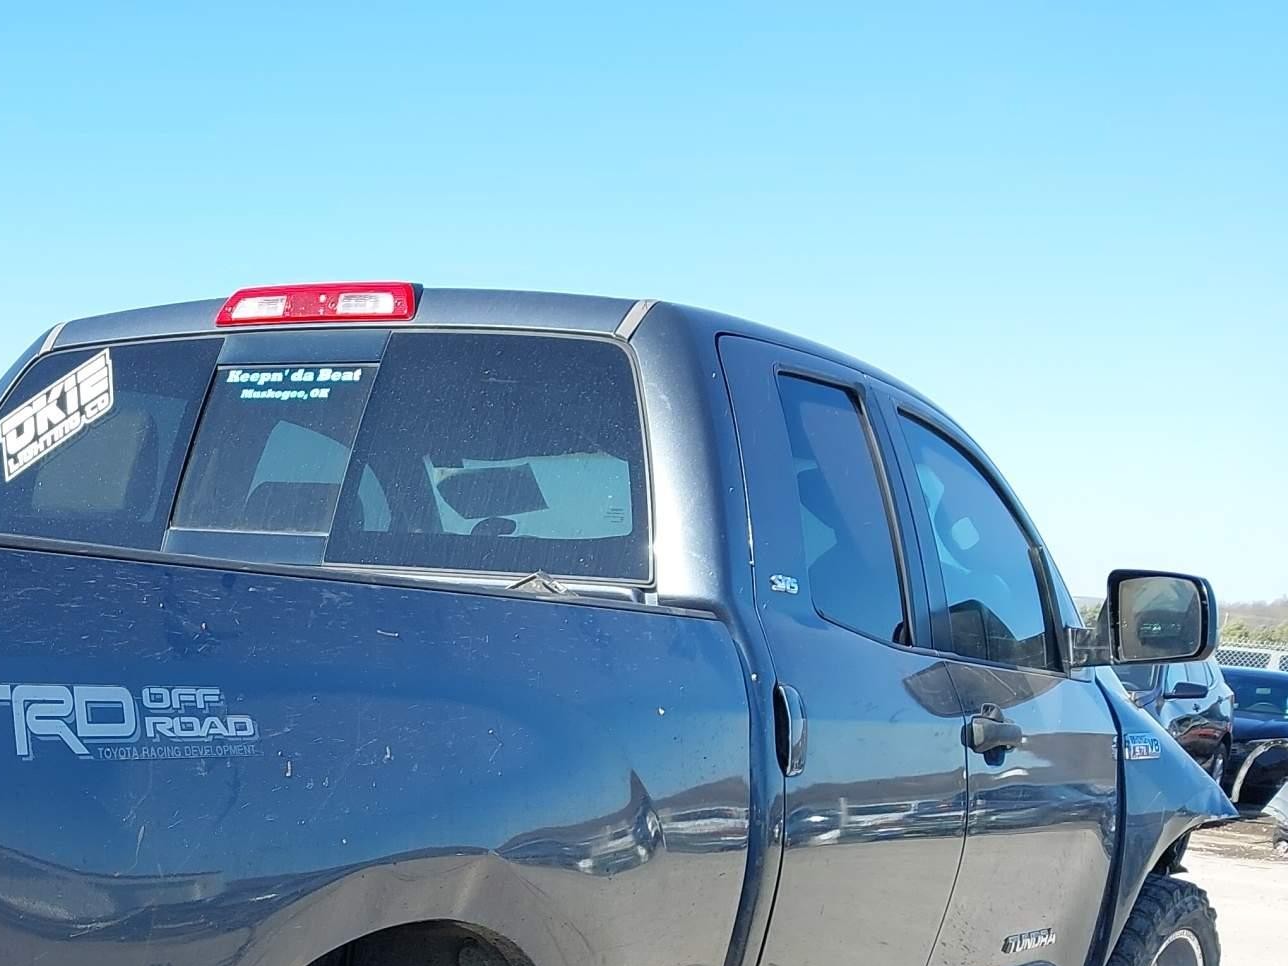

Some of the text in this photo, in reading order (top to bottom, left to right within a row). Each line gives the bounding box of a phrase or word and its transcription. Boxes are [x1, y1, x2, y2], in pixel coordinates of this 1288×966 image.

[291, 368, 314, 382] da
[317, 368, 361, 382] Beat
[309, 388, 330, 398] OK
[142, 686, 222, 711] OFF
[144, 715, 258, 739] ROAD
[97, 744, 256, 759] TOYOTA RACING DEVELOPMENT
[1002, 928, 1056, 953] TUNDRA
